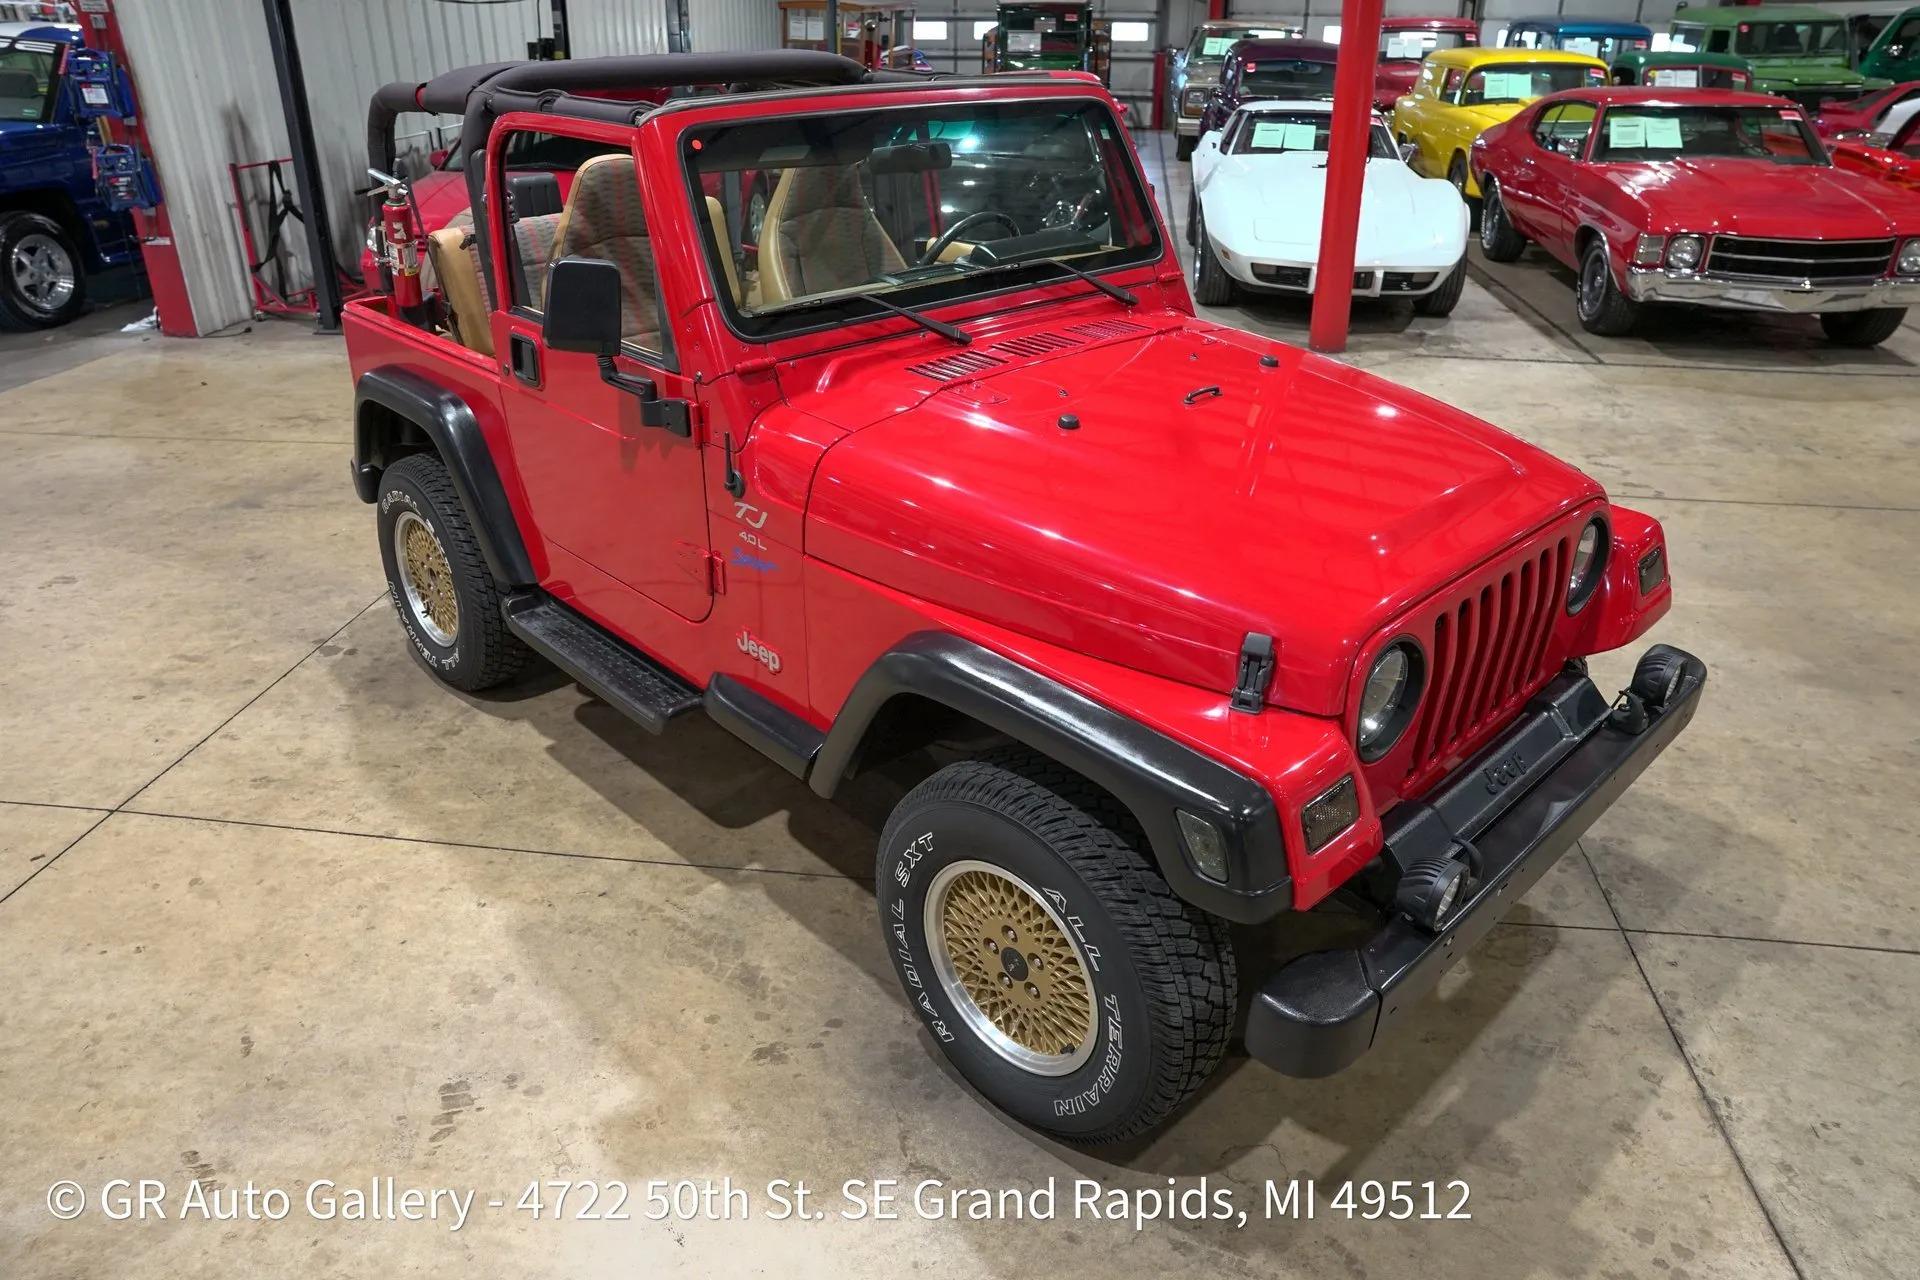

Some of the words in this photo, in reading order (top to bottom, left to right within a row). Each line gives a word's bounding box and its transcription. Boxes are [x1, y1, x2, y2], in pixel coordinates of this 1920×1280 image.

[381, 490, 422, 516] RADIAL
[734, 501, 769, 529] TJ
[736, 629, 782, 673] Jeep
[1482, 751, 1528, 795] Jeep
[895, 831, 934, 888] SXT
[1042, 886, 1101, 972] ALL
[891, 898, 955, 1043] RADIAL
[1053, 993, 1124, 1117] TERRAIN
